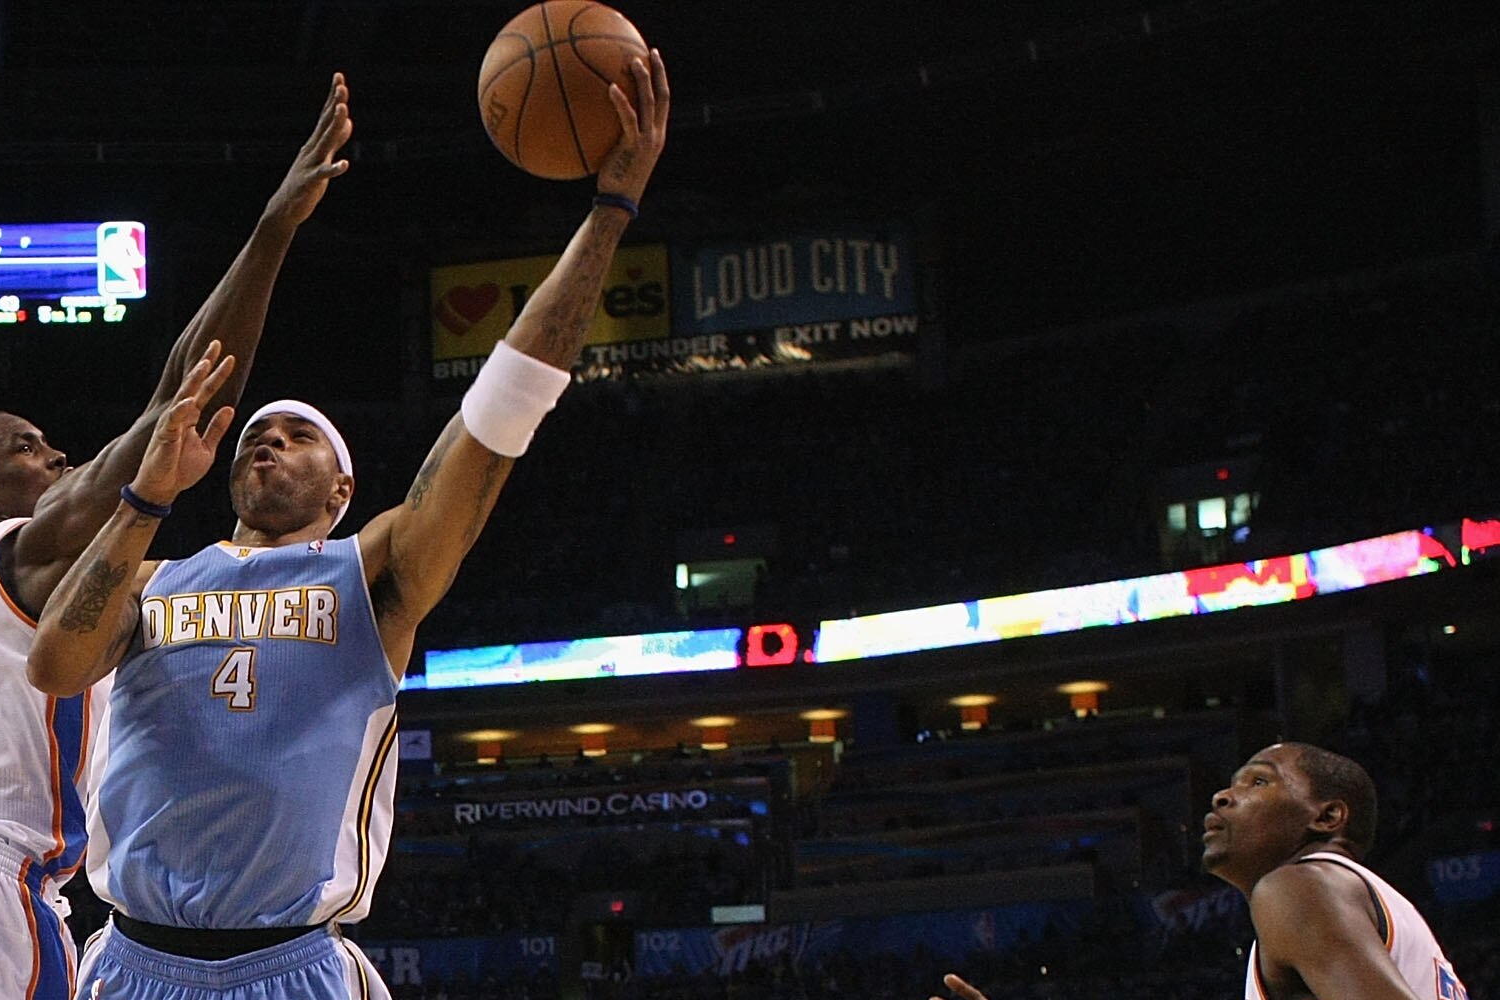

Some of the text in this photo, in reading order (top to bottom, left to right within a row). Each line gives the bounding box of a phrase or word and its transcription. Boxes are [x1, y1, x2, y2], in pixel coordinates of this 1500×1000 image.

[694, 237, 899, 321] LOUD CITY
[434, 315, 919, 380] BRI THUNDER EXIT NOW
[141, 585, 339, 650] DENVER
[211, 647, 257, 711] 4
[454, 789, 709, 825] RIVERWIND CASINO
[519, 936, 556, 957] 101
[638, 932, 682, 952] 102
